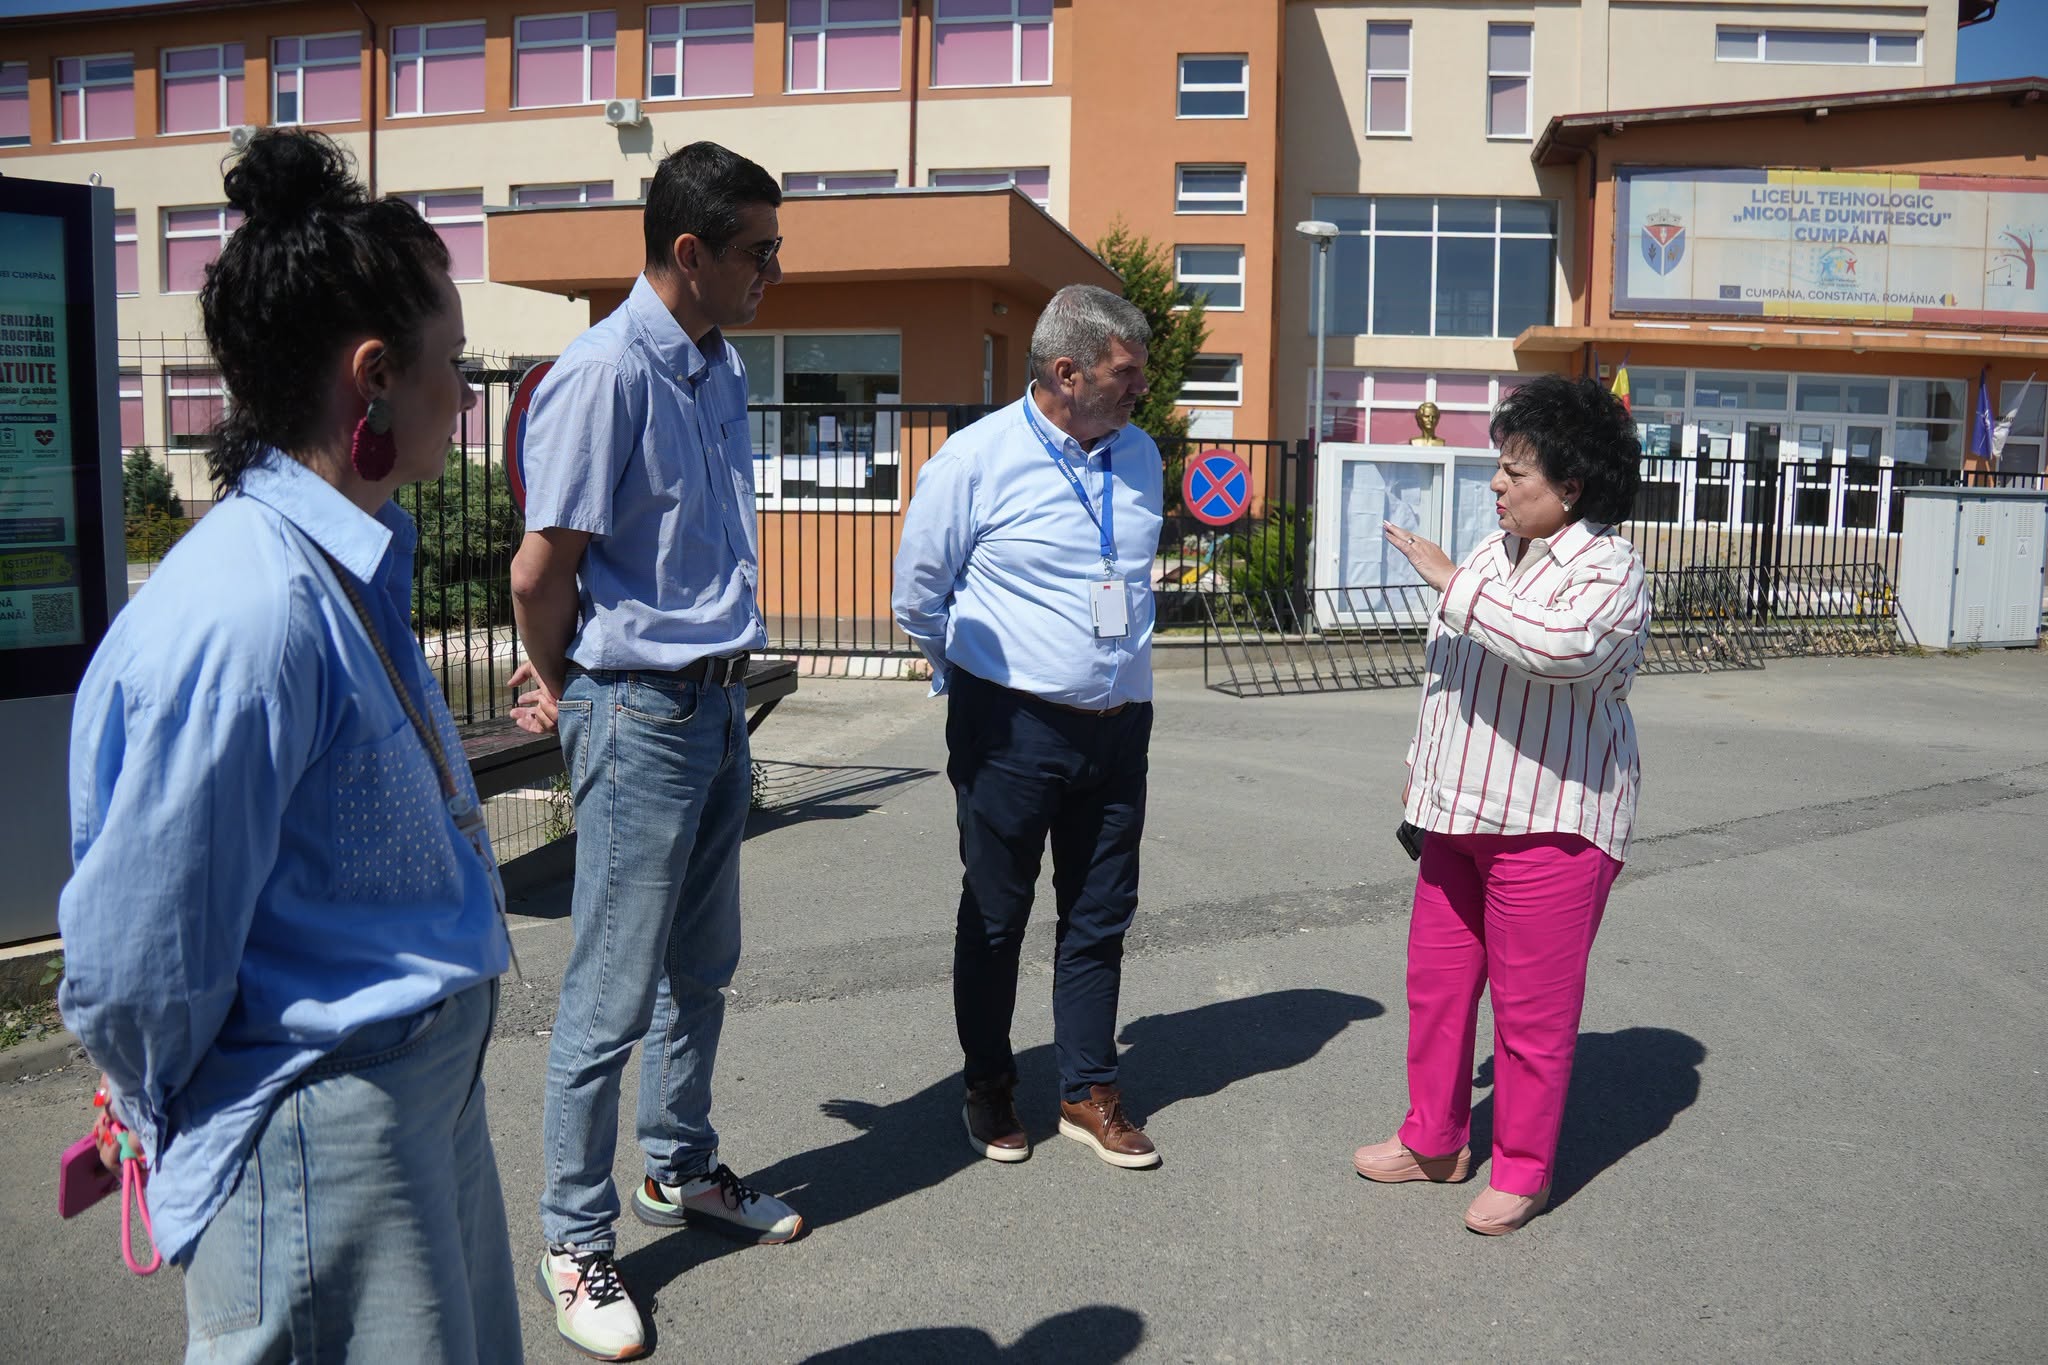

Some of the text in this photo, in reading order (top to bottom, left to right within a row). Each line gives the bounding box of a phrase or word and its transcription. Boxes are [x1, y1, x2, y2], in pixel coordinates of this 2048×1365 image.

[1751, 189, 1934, 209] LICEUL TEHNOLOGIC
[1794, 225, 1888, 244] CUMPĂNA
[1745, 287, 1805, 300] CUMPĂNA,
[1882, 292, 1936, 305] ROMÂNIA
[1058, 458, 1078, 484] busworld
